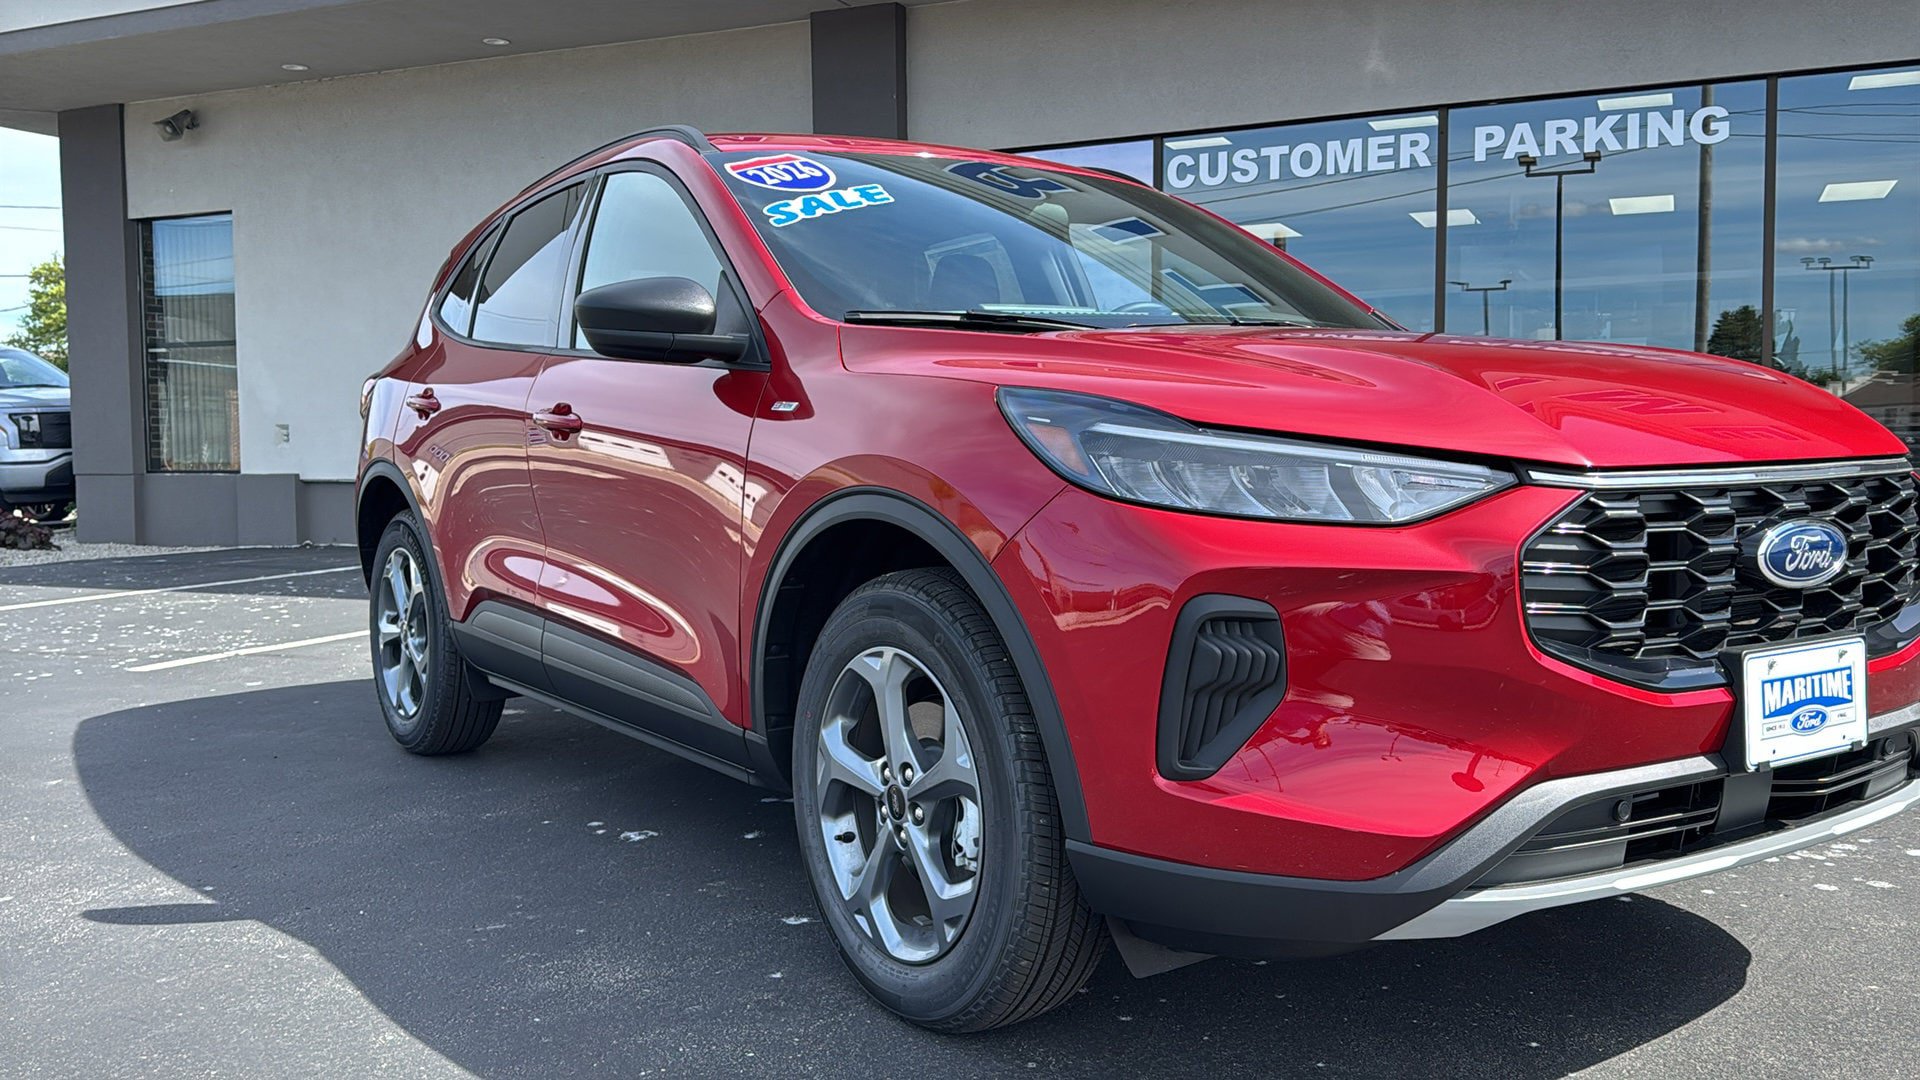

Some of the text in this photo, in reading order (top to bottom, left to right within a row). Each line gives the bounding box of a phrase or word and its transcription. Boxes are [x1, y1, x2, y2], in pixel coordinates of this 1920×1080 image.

[1166, 105, 1731, 188] CUSTOMER PARKING
[749, 160, 822, 185] 2026
[765, 184, 892, 227] SALE
[1785, 534, 1833, 572] Ford
[1763, 668, 1852, 717] MARITIME
[1797, 711, 1823, 730] Ford
